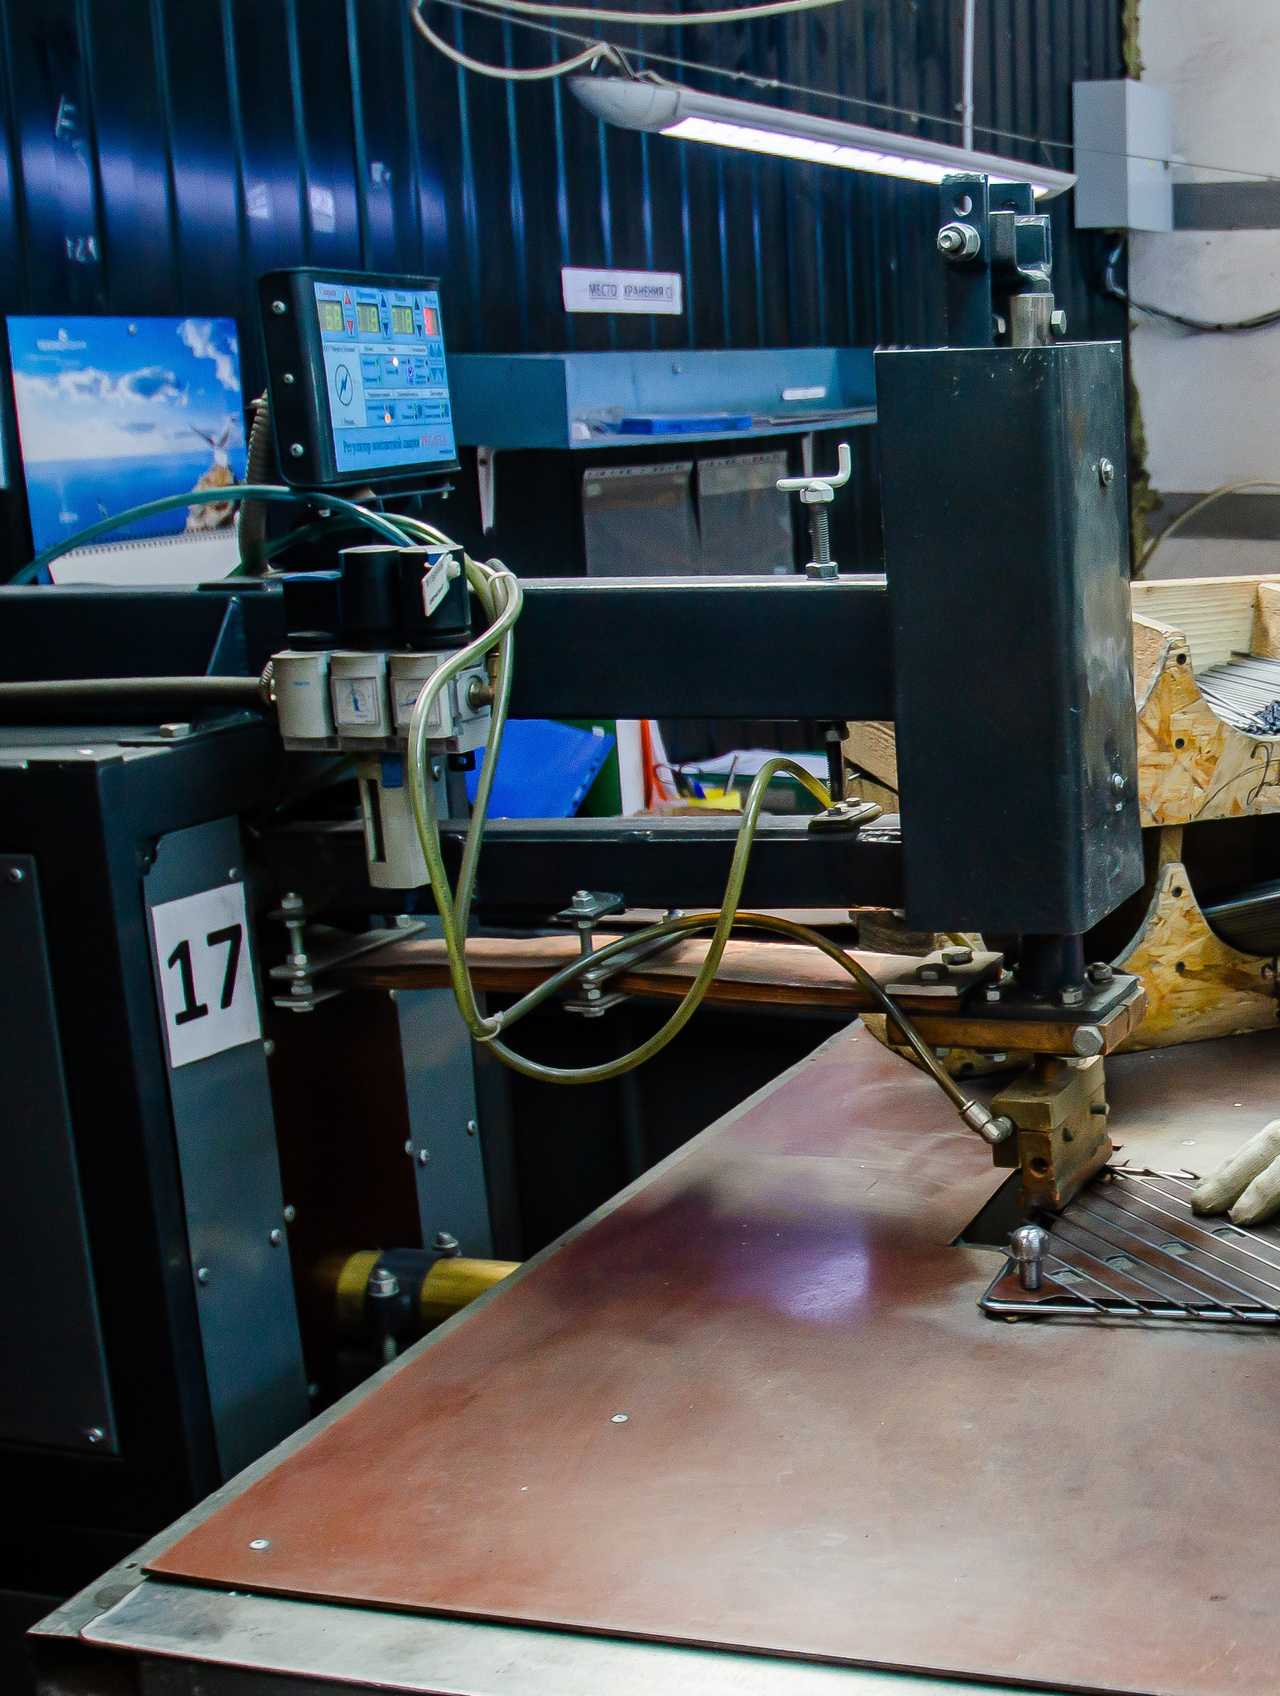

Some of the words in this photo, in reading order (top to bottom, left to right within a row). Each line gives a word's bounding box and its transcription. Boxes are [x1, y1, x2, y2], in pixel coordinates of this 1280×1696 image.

[588, 284, 617, 298] МЕСТО
[623, 285, 664, 299] ХРАНЕНИЯ
[167, 923, 243, 1026] 17
